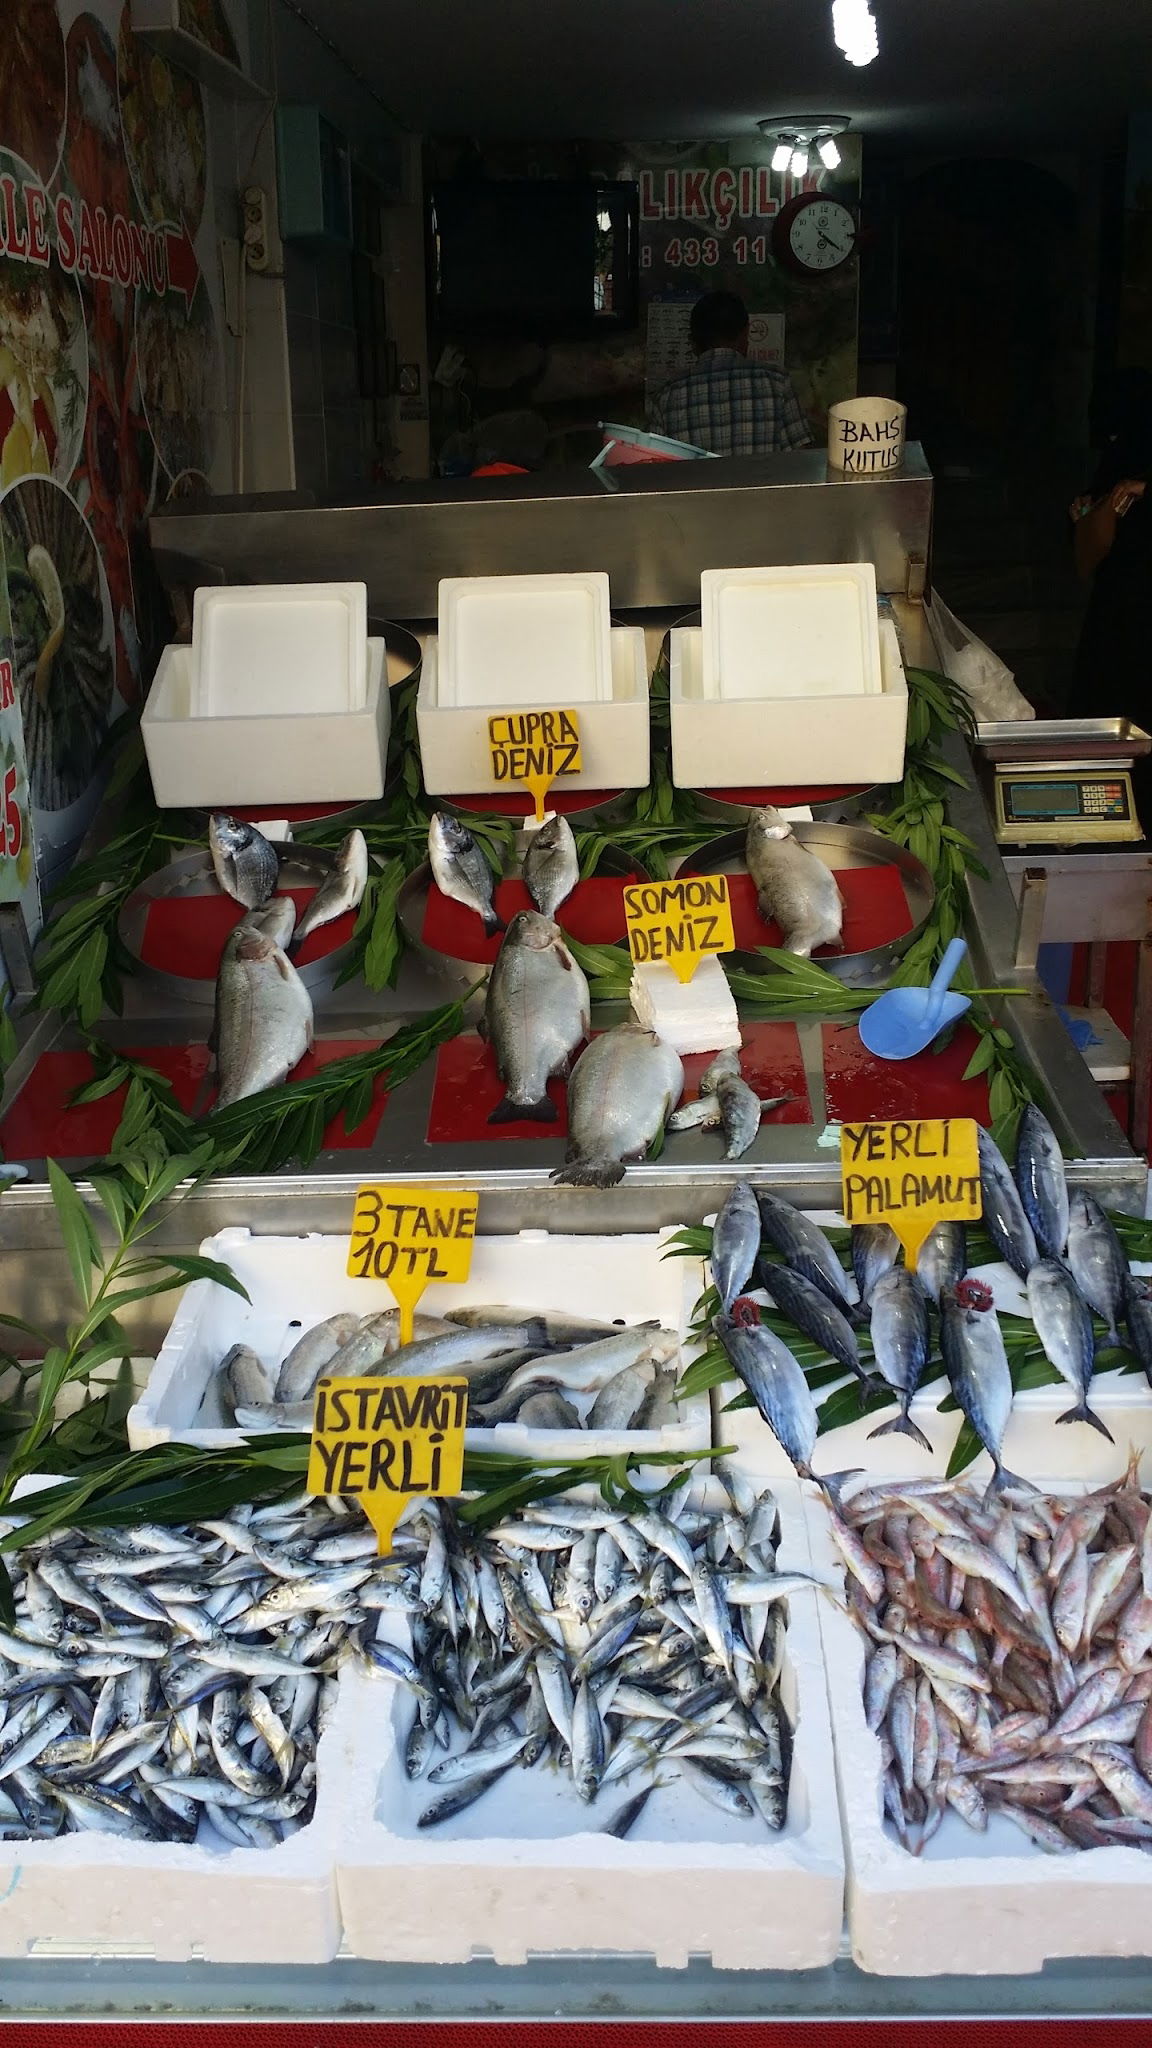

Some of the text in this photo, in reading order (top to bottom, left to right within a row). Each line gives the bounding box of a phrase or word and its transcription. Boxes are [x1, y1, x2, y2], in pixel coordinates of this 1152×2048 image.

[0, 176, 168, 296] LE SALONU
[665, 239, 719, 266] 433
[733, 237, 767, 264] 11
[490, 711, 579, 748] ÇUPRA
[624, 876, 727, 920] SOMON
[631, 914, 724, 962] DENİZ
[352, 1190, 477, 1239] 3 TANE
[845, 1172, 981, 1221] PALAMUT
[315, 1432, 445, 1494] YERLİ
